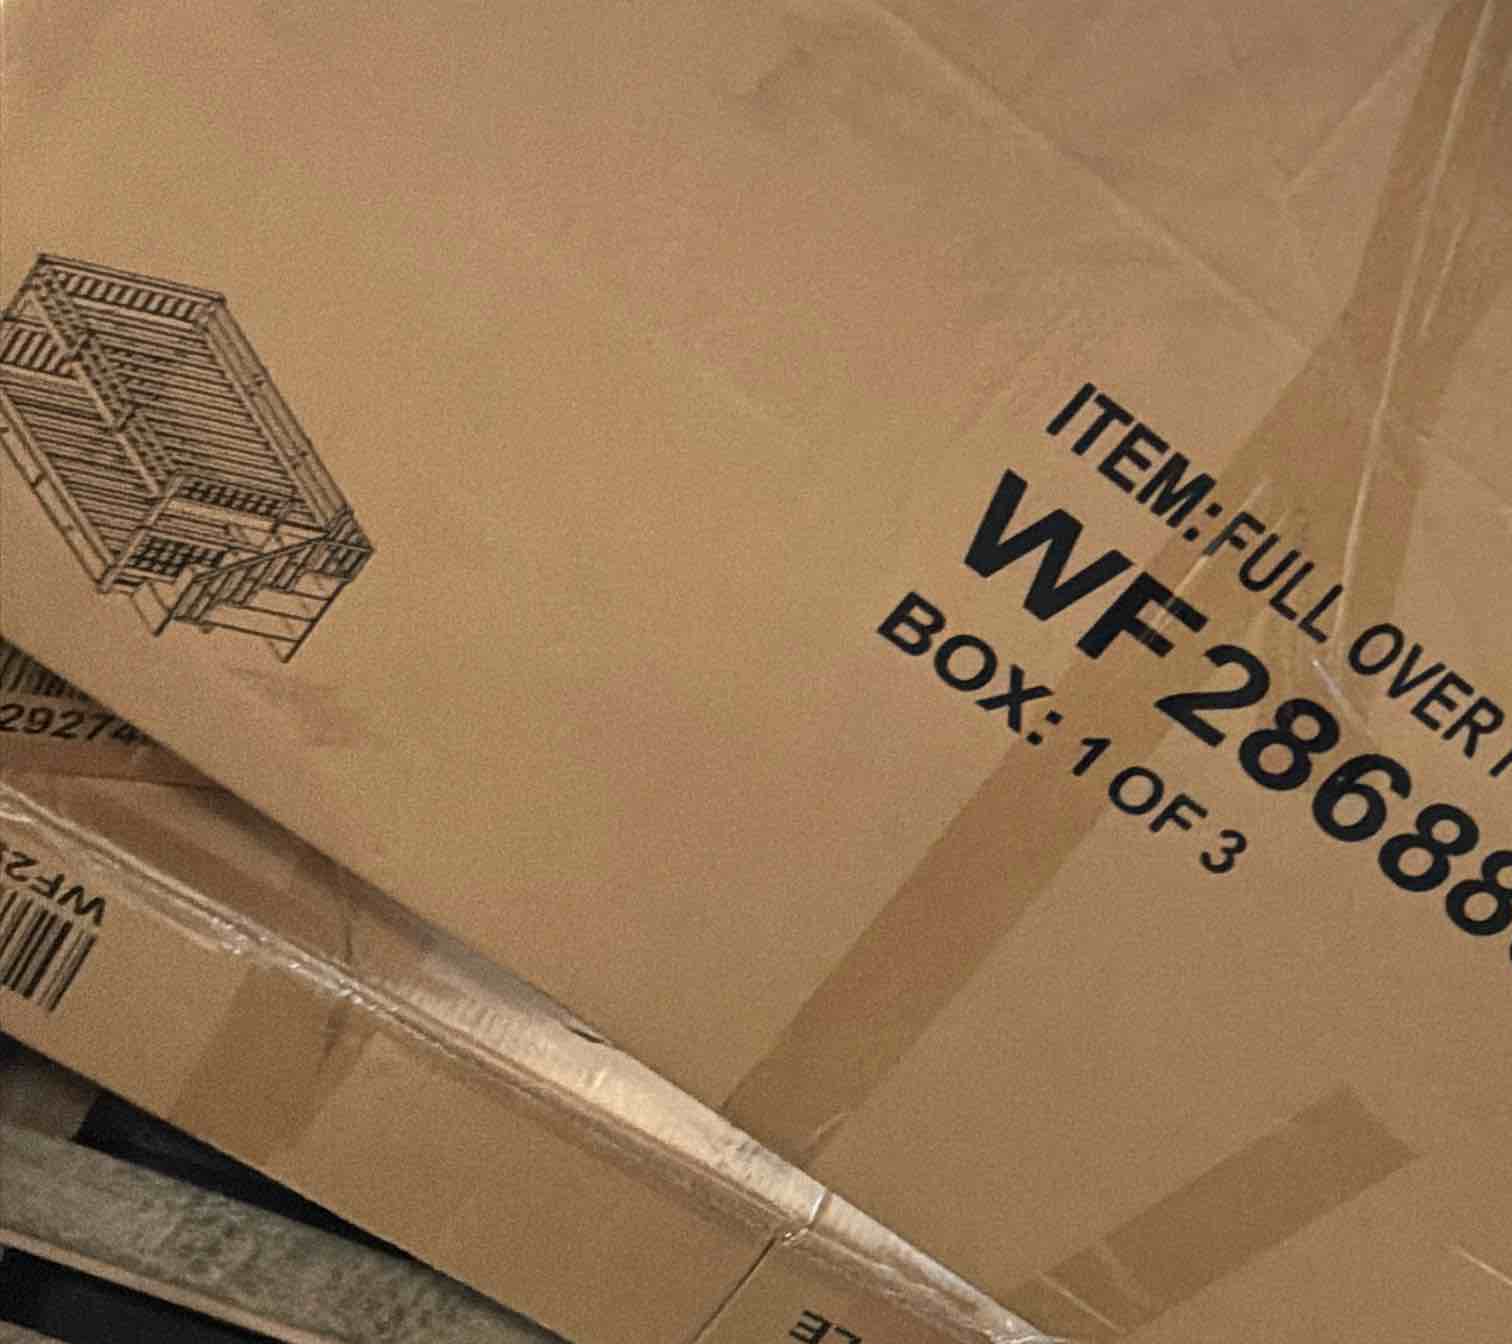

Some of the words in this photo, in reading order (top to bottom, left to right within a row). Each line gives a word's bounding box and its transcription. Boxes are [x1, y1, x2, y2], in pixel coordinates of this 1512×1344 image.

[0, 703, 154, 747] 29274
[876, 590, 1064, 746] BOX:
[1071, 736, 1112, 777] 1
[1107, 766, 1209, 833] OF
[1200, 829, 1248, 875] 3
[1347, 622, 1506, 759] OVER
[0, 840, 106, 926] WF2
